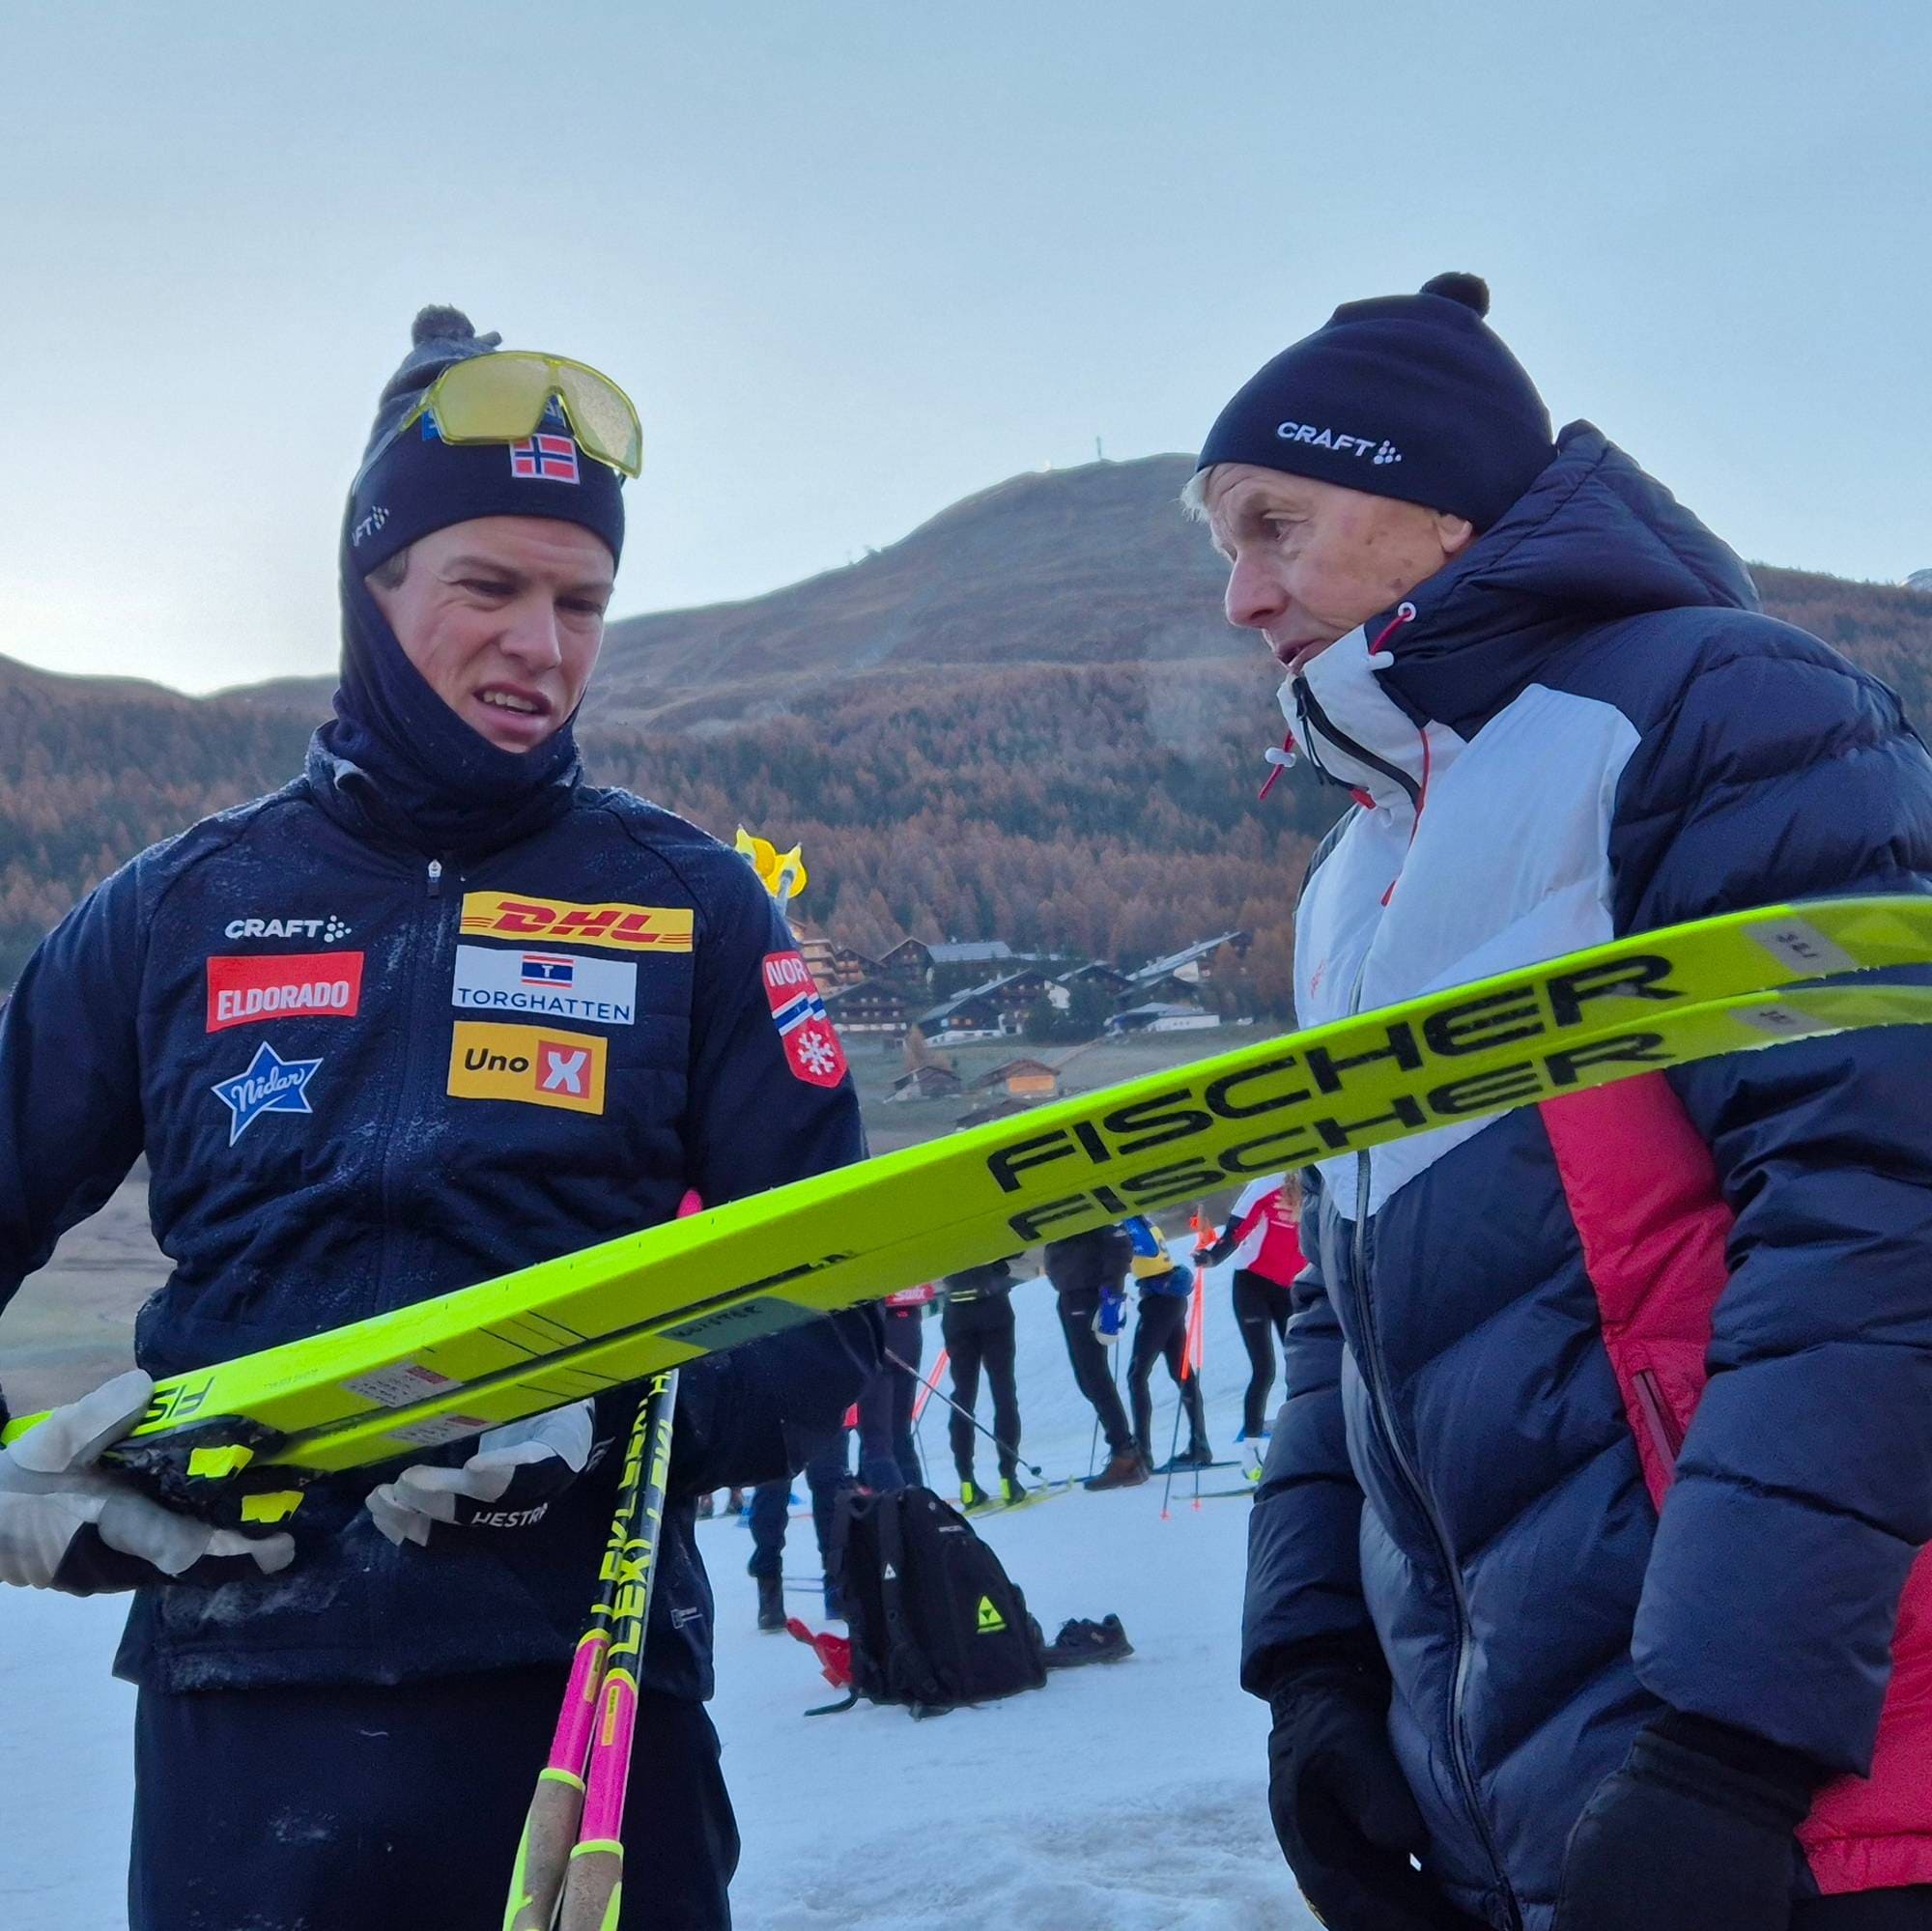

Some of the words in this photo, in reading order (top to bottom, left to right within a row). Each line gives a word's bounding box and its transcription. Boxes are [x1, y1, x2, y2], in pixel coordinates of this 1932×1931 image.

[1277, 421, 1377, 457] CRAFT
[224, 918, 325, 939] CRAFT
[490, 900, 662, 944] DHL
[765, 957, 809, 987] NOR
[216, 980, 350, 1021] ELDORADO
[457, 987, 630, 1022] TORGHATTEN
[230, 1065, 305, 1113] Nidar
[465, 1047, 530, 1073] Uno
[541, 1050, 588, 1094] X
[986, 953, 1688, 1193] FISCHER
[1008, 1032, 1677, 1242] FISCHER
[607, 1538, 654, 1660] LEKI
